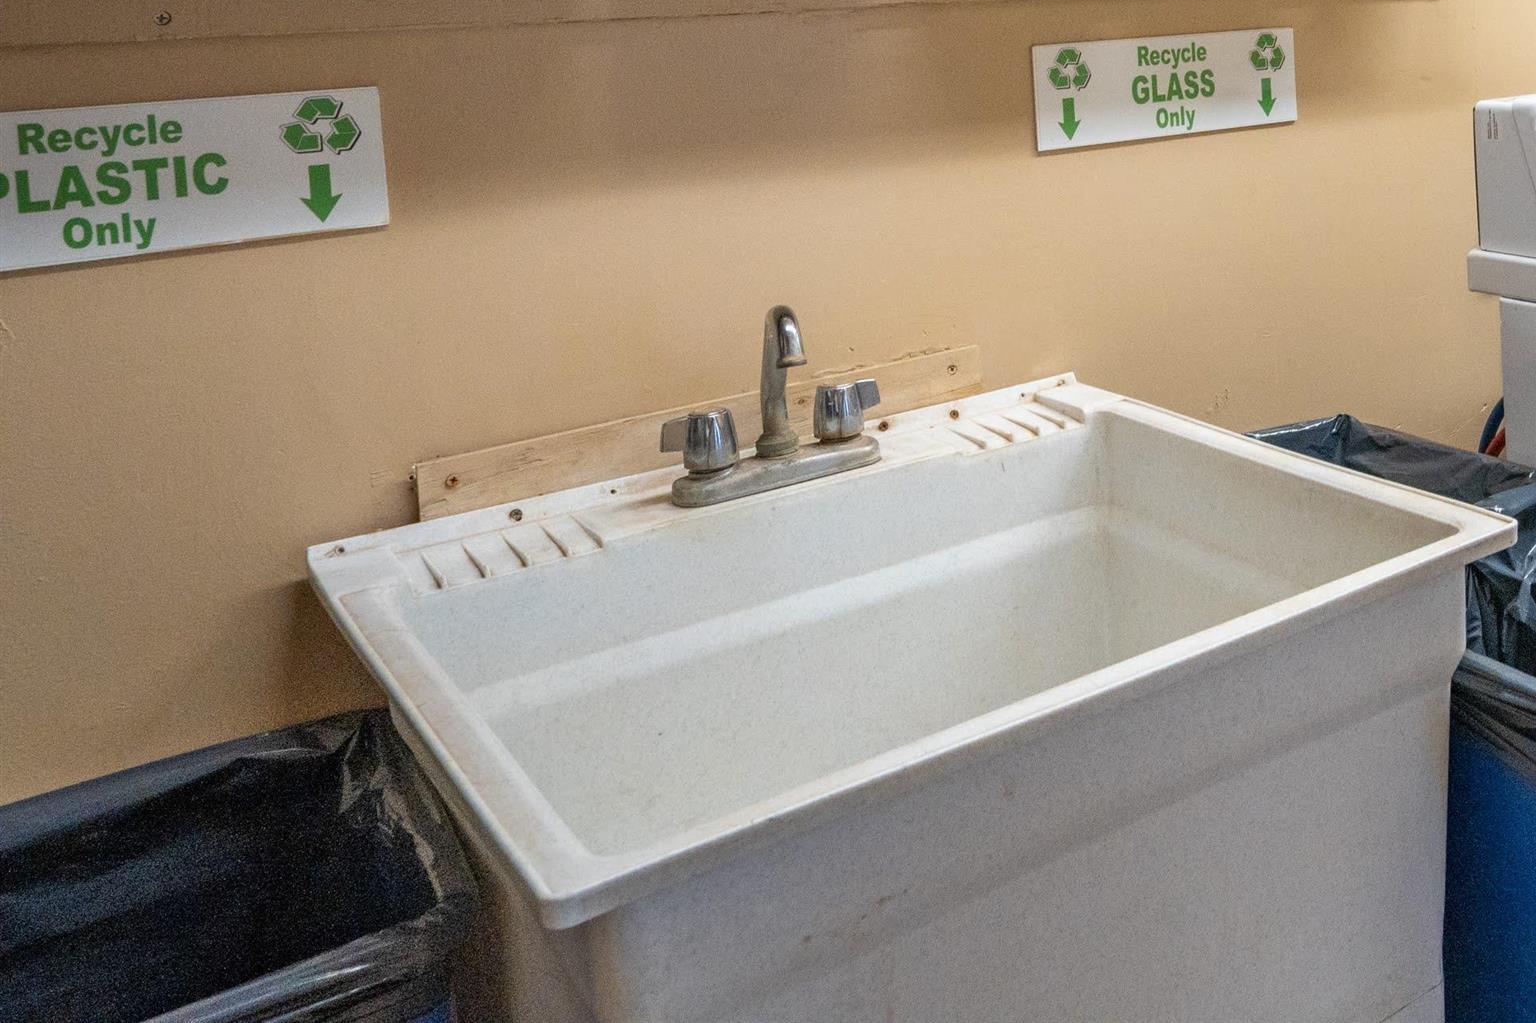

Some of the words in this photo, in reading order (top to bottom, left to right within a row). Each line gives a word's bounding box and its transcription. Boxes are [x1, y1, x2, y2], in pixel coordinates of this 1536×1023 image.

[1137, 42, 1207, 69] Recycle
[1131, 69, 1216, 105] GLASS
[16, 114, 183, 157] Recycle
[1156, 106, 1195, 131] Only
[62, 212, 157, 250] Only
